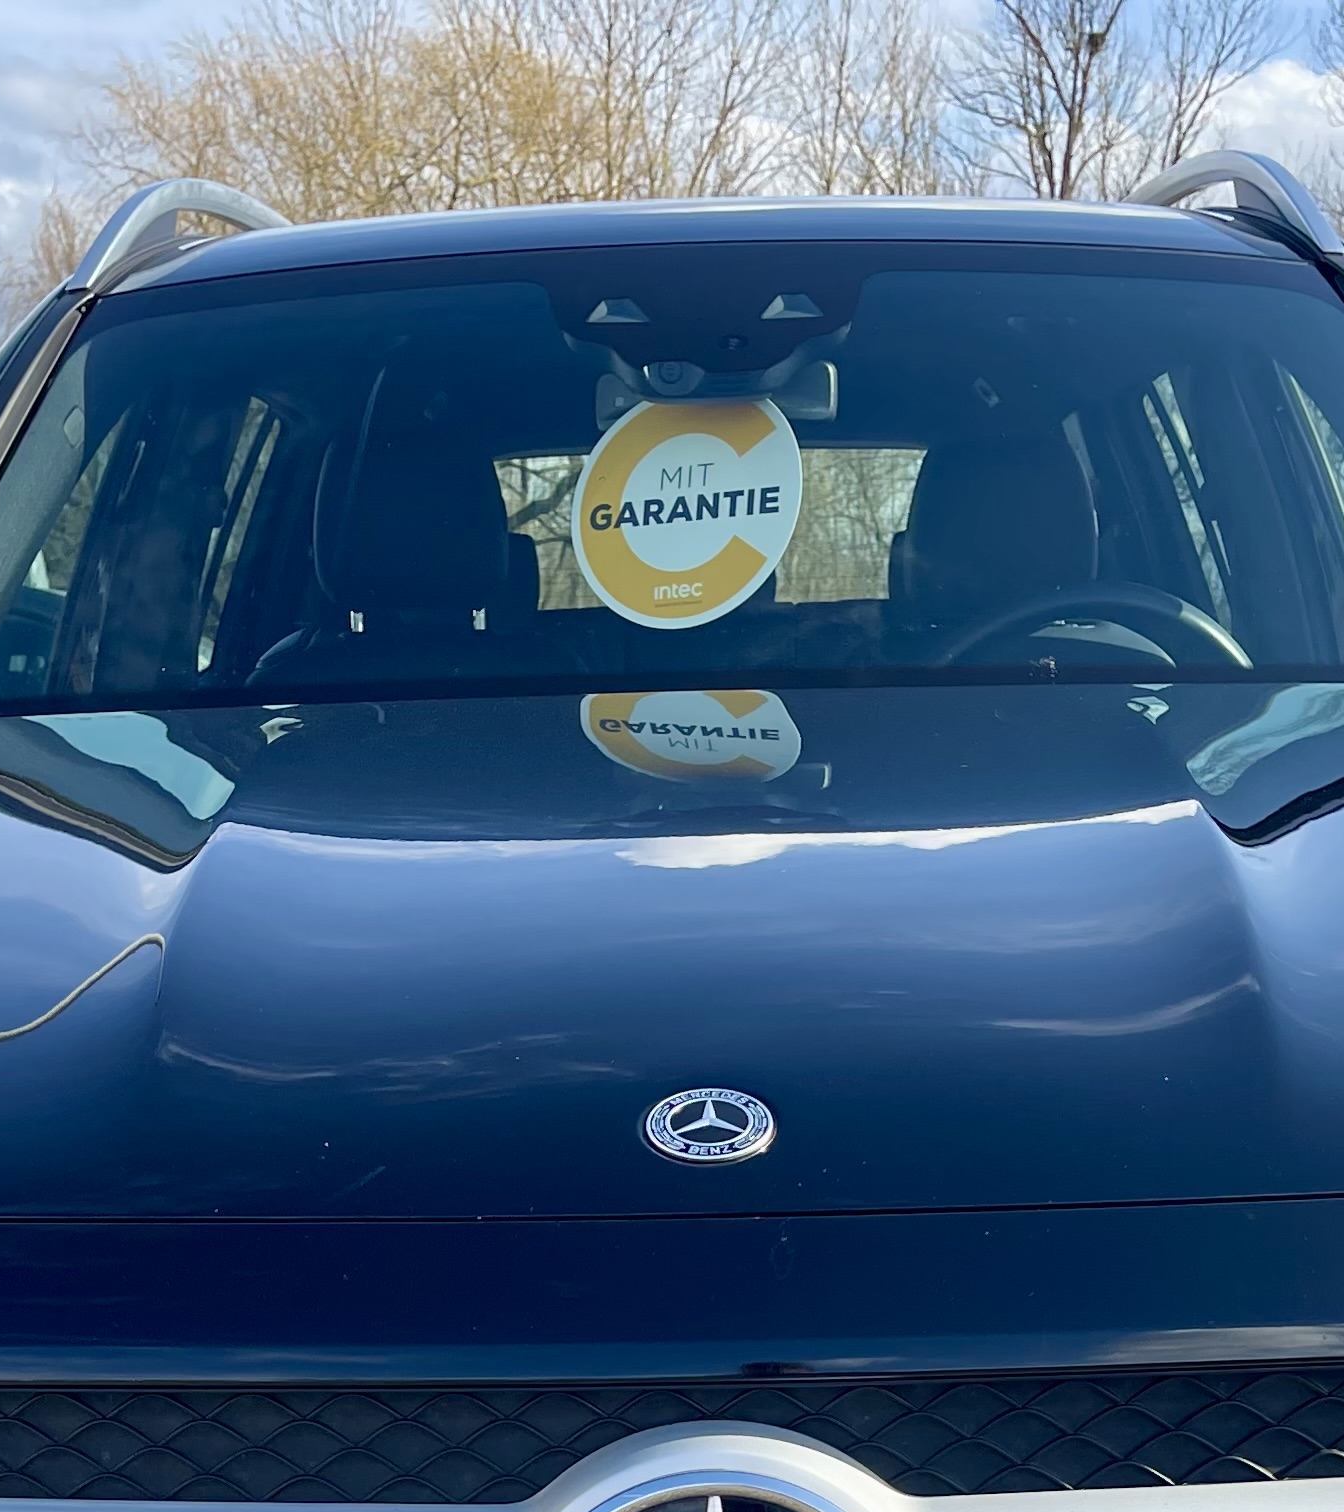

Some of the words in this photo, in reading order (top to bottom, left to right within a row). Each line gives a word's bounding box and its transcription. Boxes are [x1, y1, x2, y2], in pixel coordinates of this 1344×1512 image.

[659, 462, 716, 492] MIT
[589, 486, 780, 531] GARANTIE
[669, 1090, 751, 1106] MERCEDES
[687, 1144, 734, 1155] BENZ
